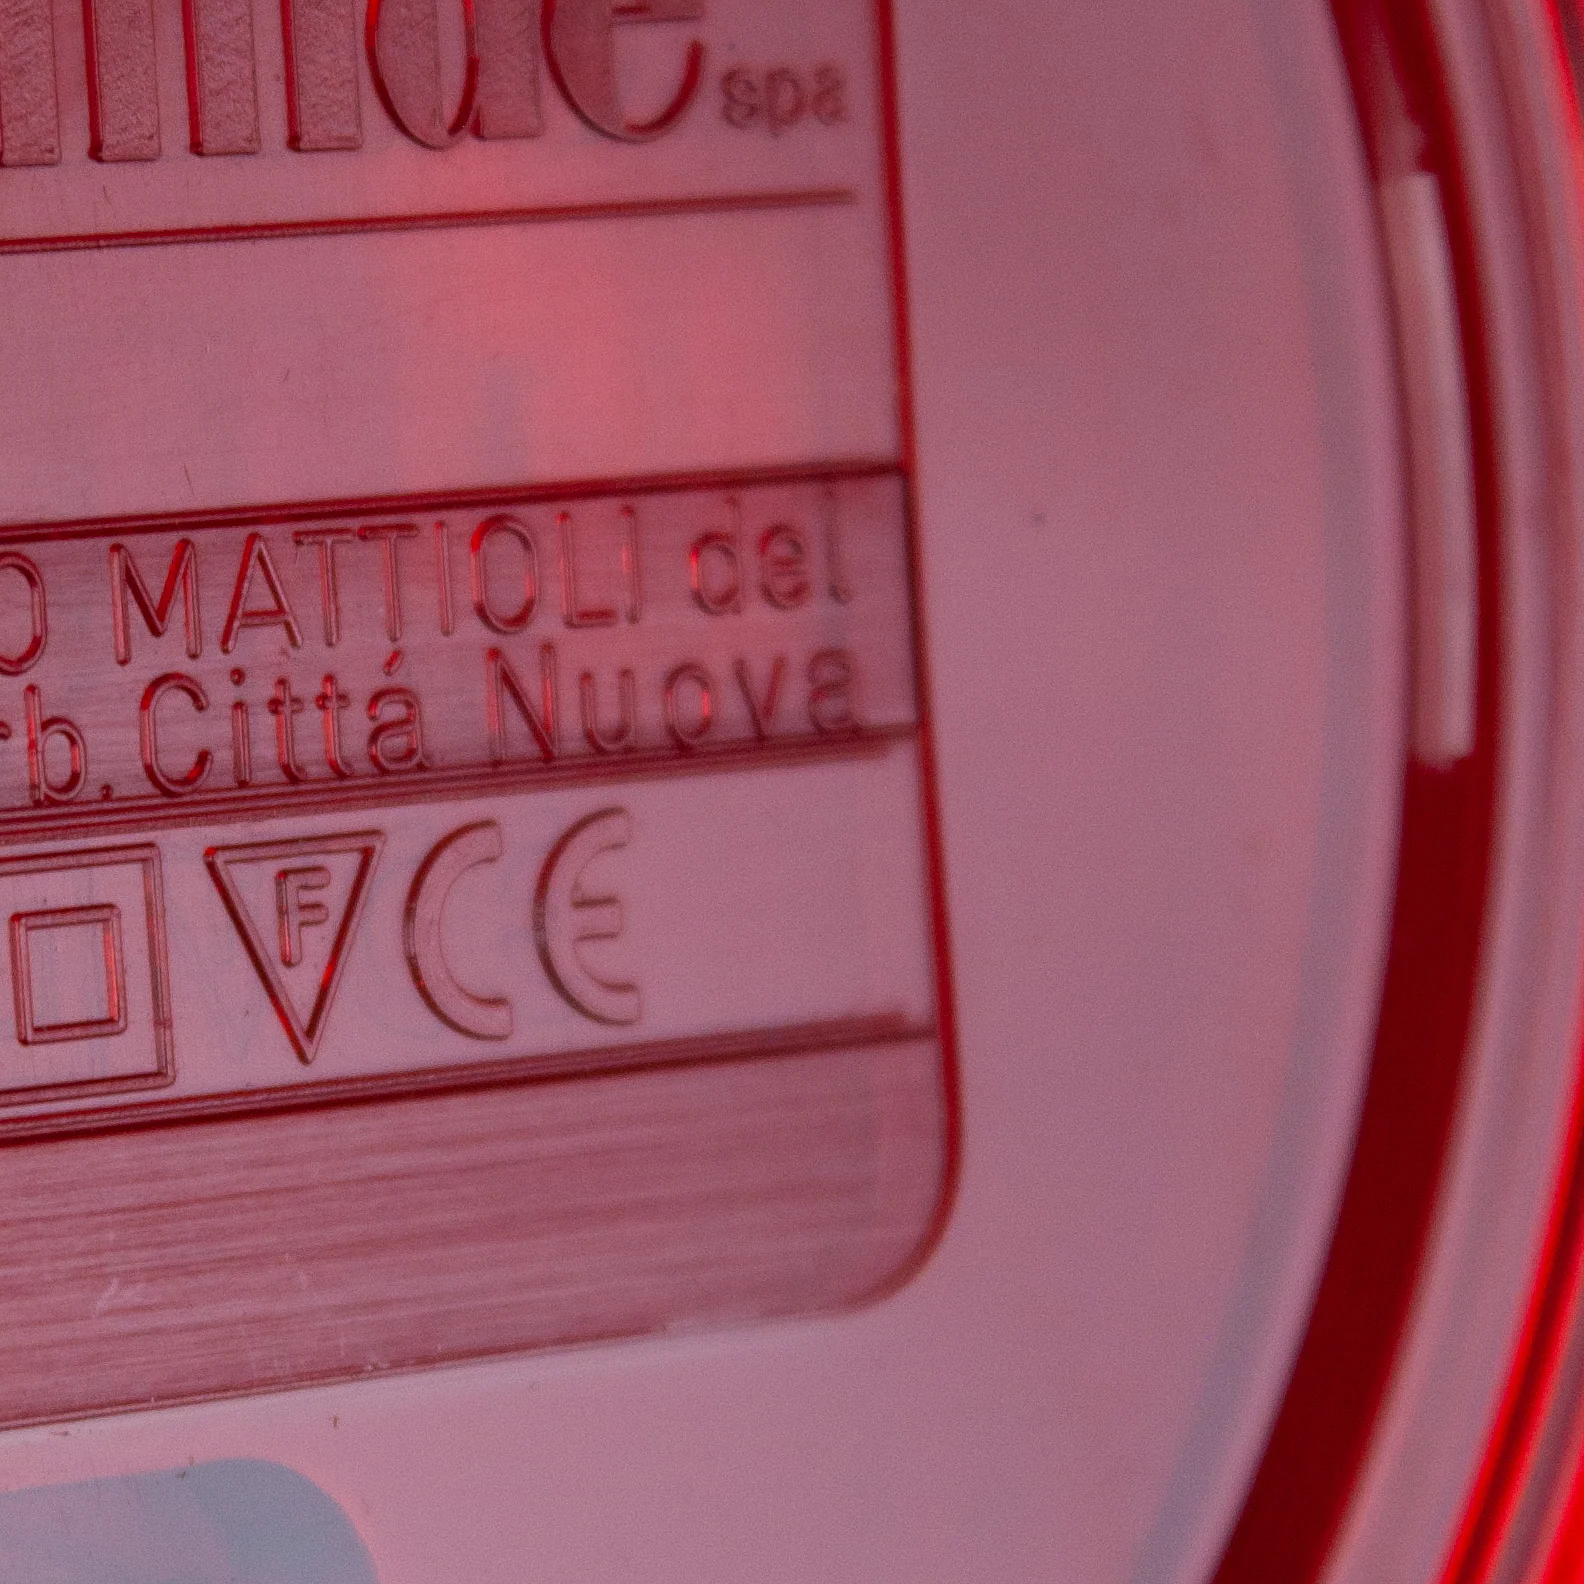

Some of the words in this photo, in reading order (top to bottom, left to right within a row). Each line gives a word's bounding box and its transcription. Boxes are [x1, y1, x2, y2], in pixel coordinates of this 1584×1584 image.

[718, 56, 848, 138] spa
[110, 504, 641, 667] MATTIOLI
[687, 488, 854, 616] del
[483, 641, 864, 764] Nuova
[273, 866, 331, 967] F
[403, 807, 642, 1042] CE
